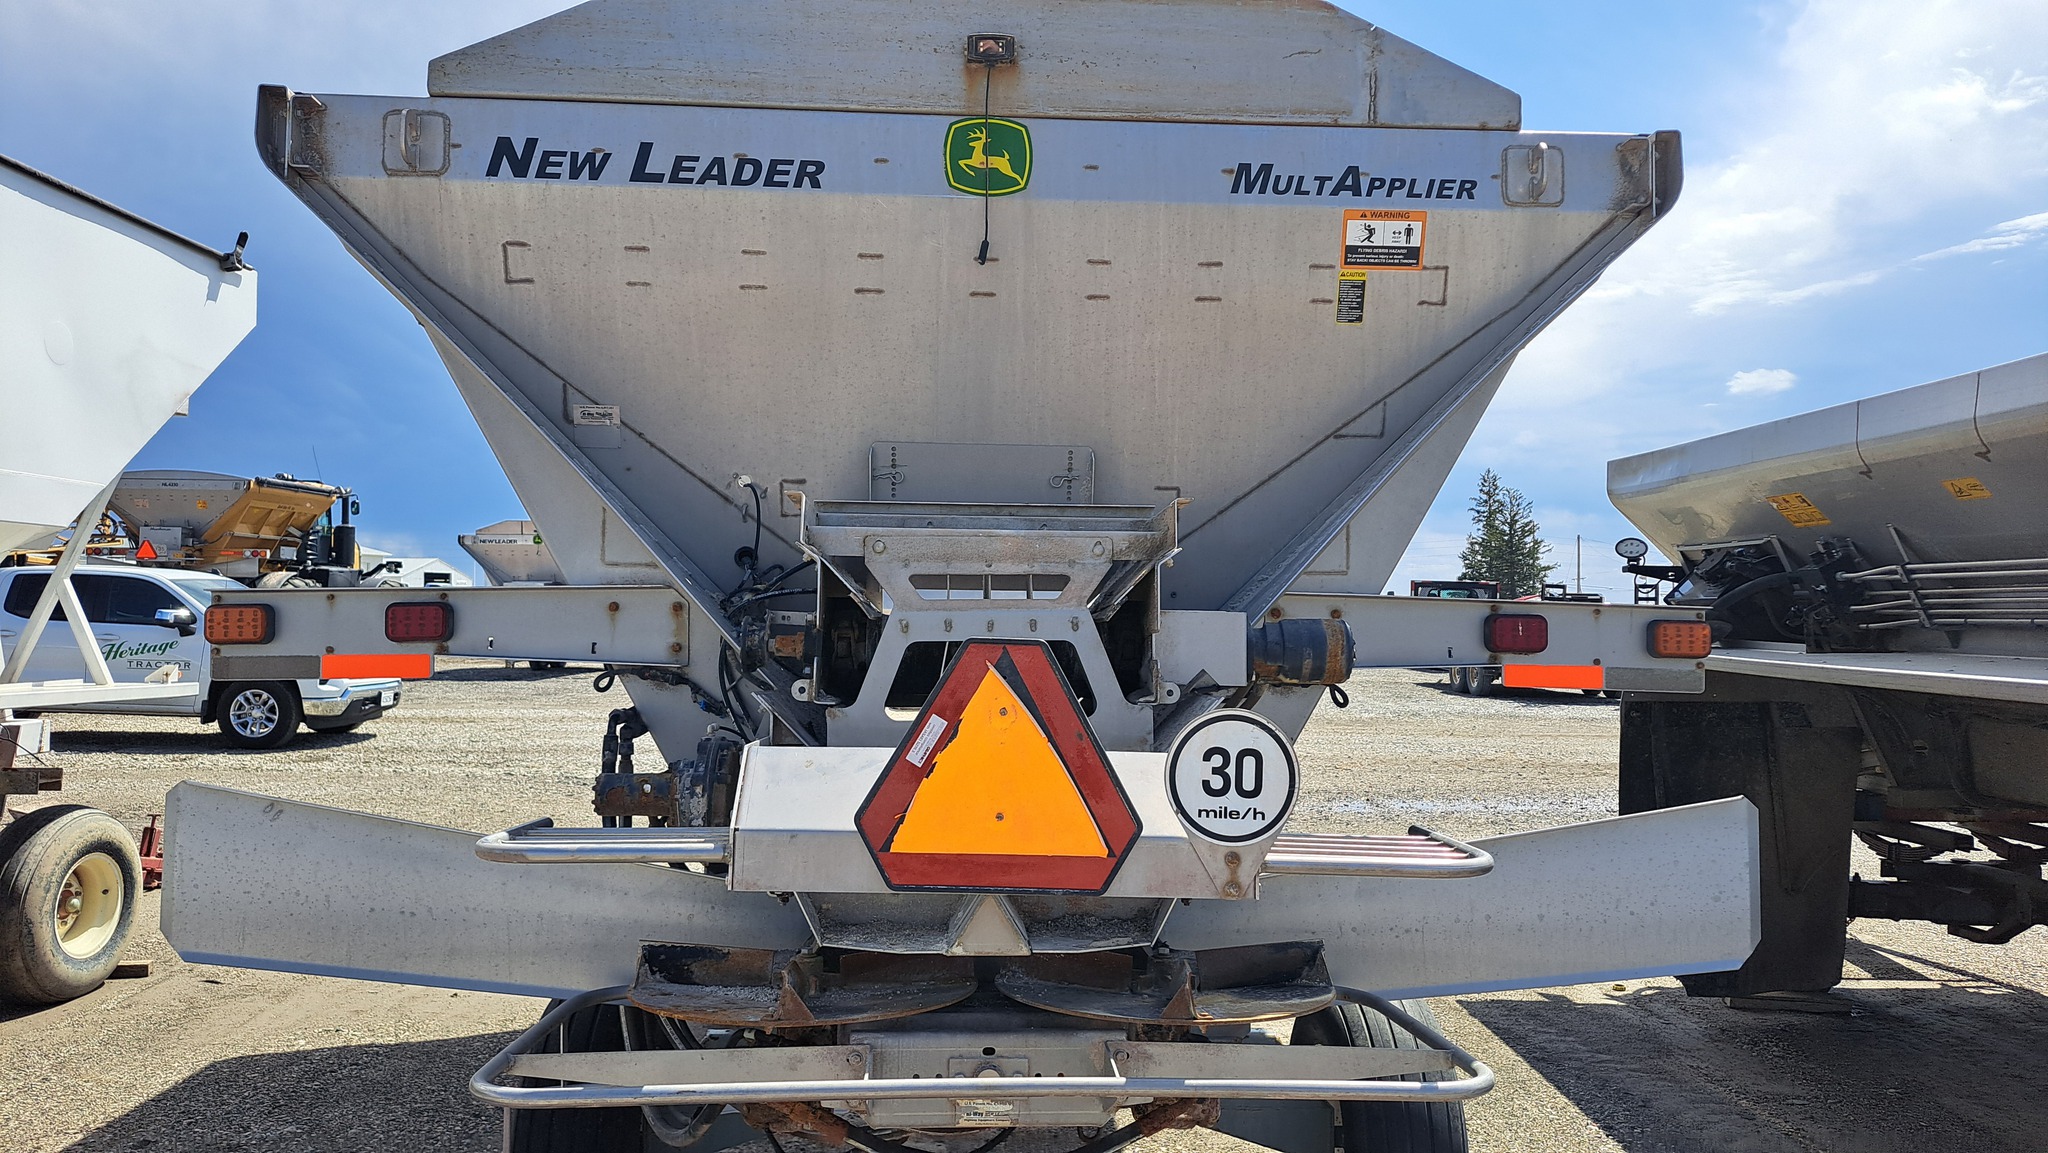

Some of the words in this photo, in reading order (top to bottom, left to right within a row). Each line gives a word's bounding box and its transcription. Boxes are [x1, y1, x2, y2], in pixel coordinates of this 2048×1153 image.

[1370, 211, 1411, 219] WARNING
[101, 640, 179, 661] Heritage
[1201, 746, 1264, 799] 30
[1197, 806, 1266, 821] mile/h
